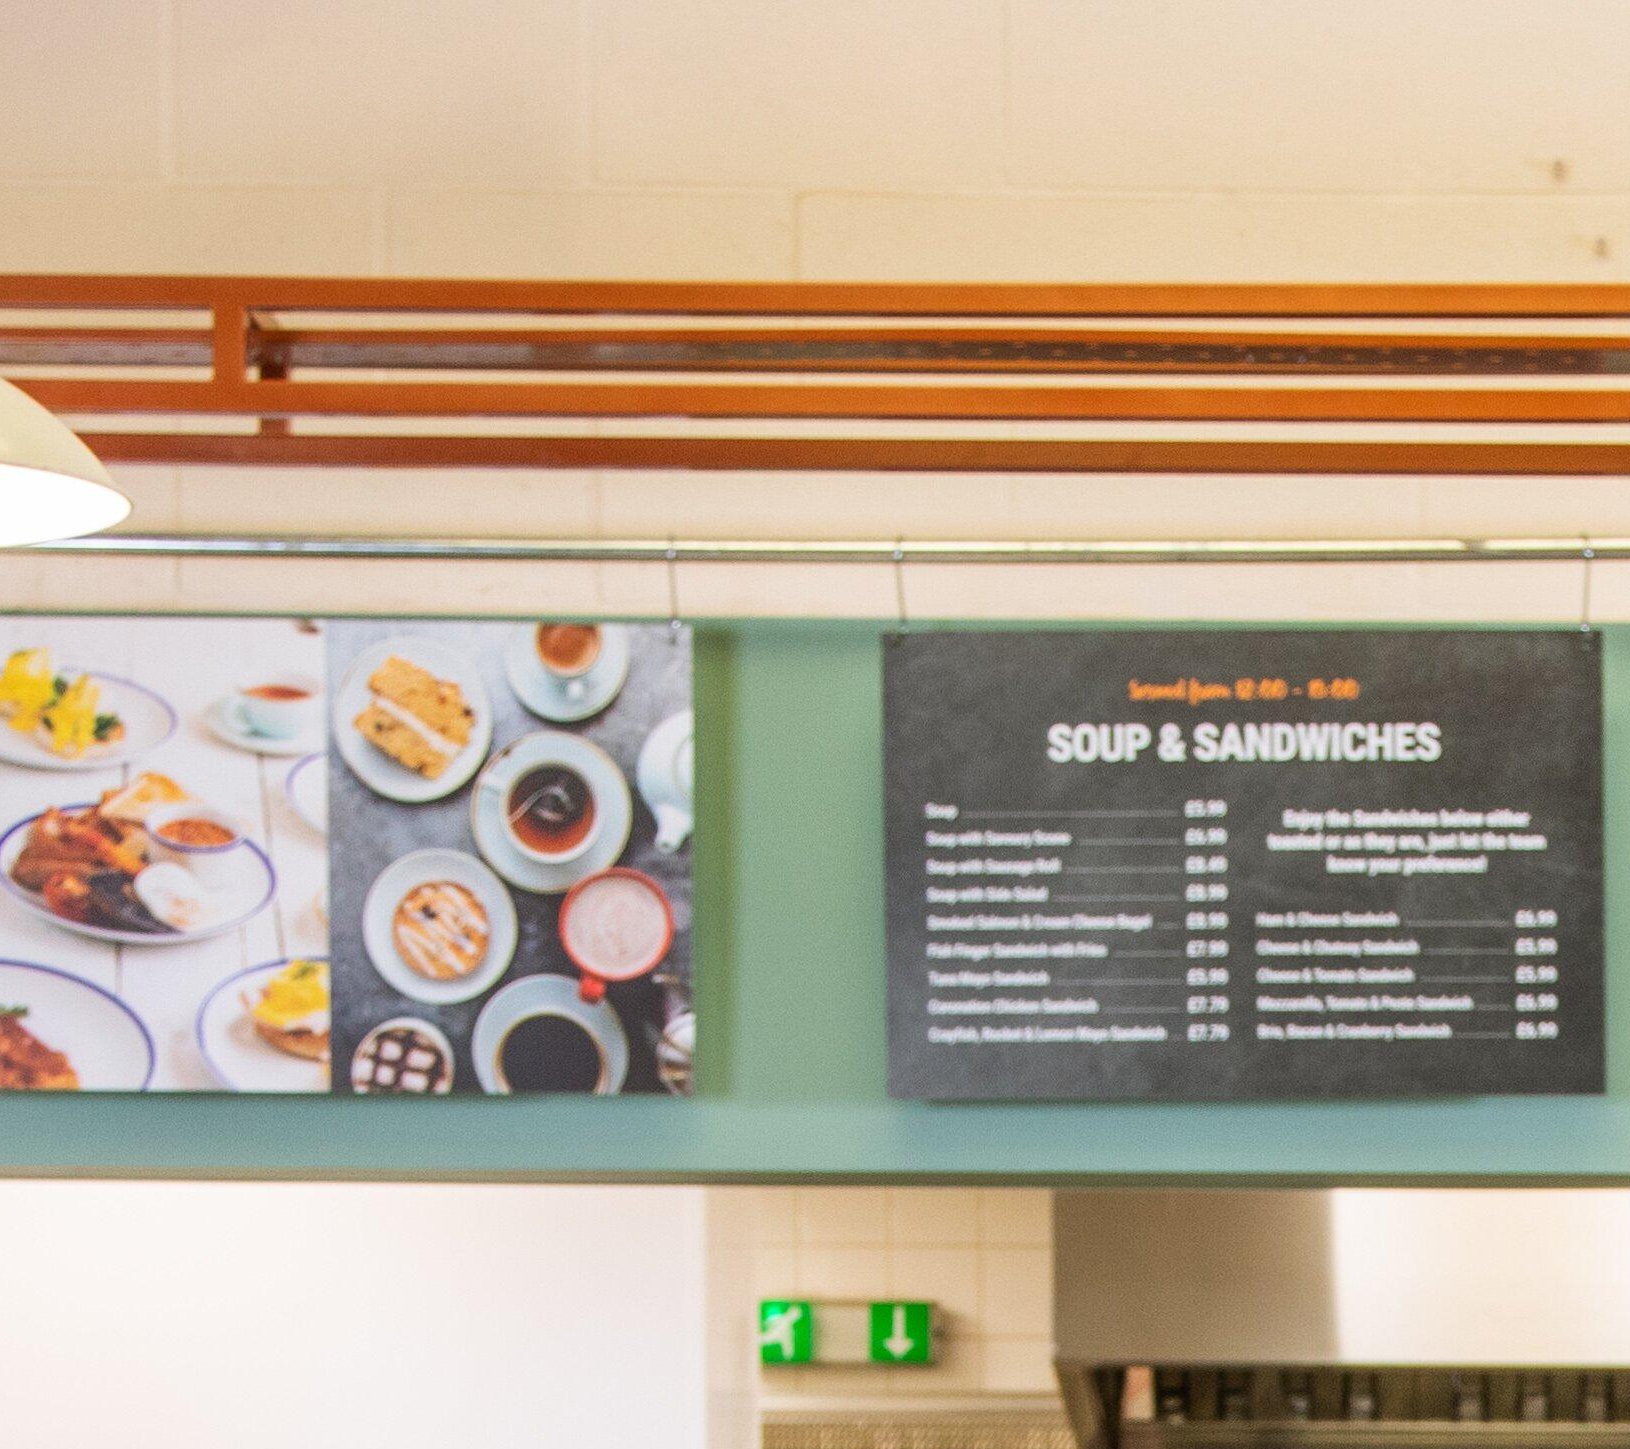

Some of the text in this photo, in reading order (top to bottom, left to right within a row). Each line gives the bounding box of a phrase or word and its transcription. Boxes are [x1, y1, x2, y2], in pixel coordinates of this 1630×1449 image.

[1047, 721, 1442, 763] SOUP & SANDWICHES
[1325, 808, 1352, 828] the
